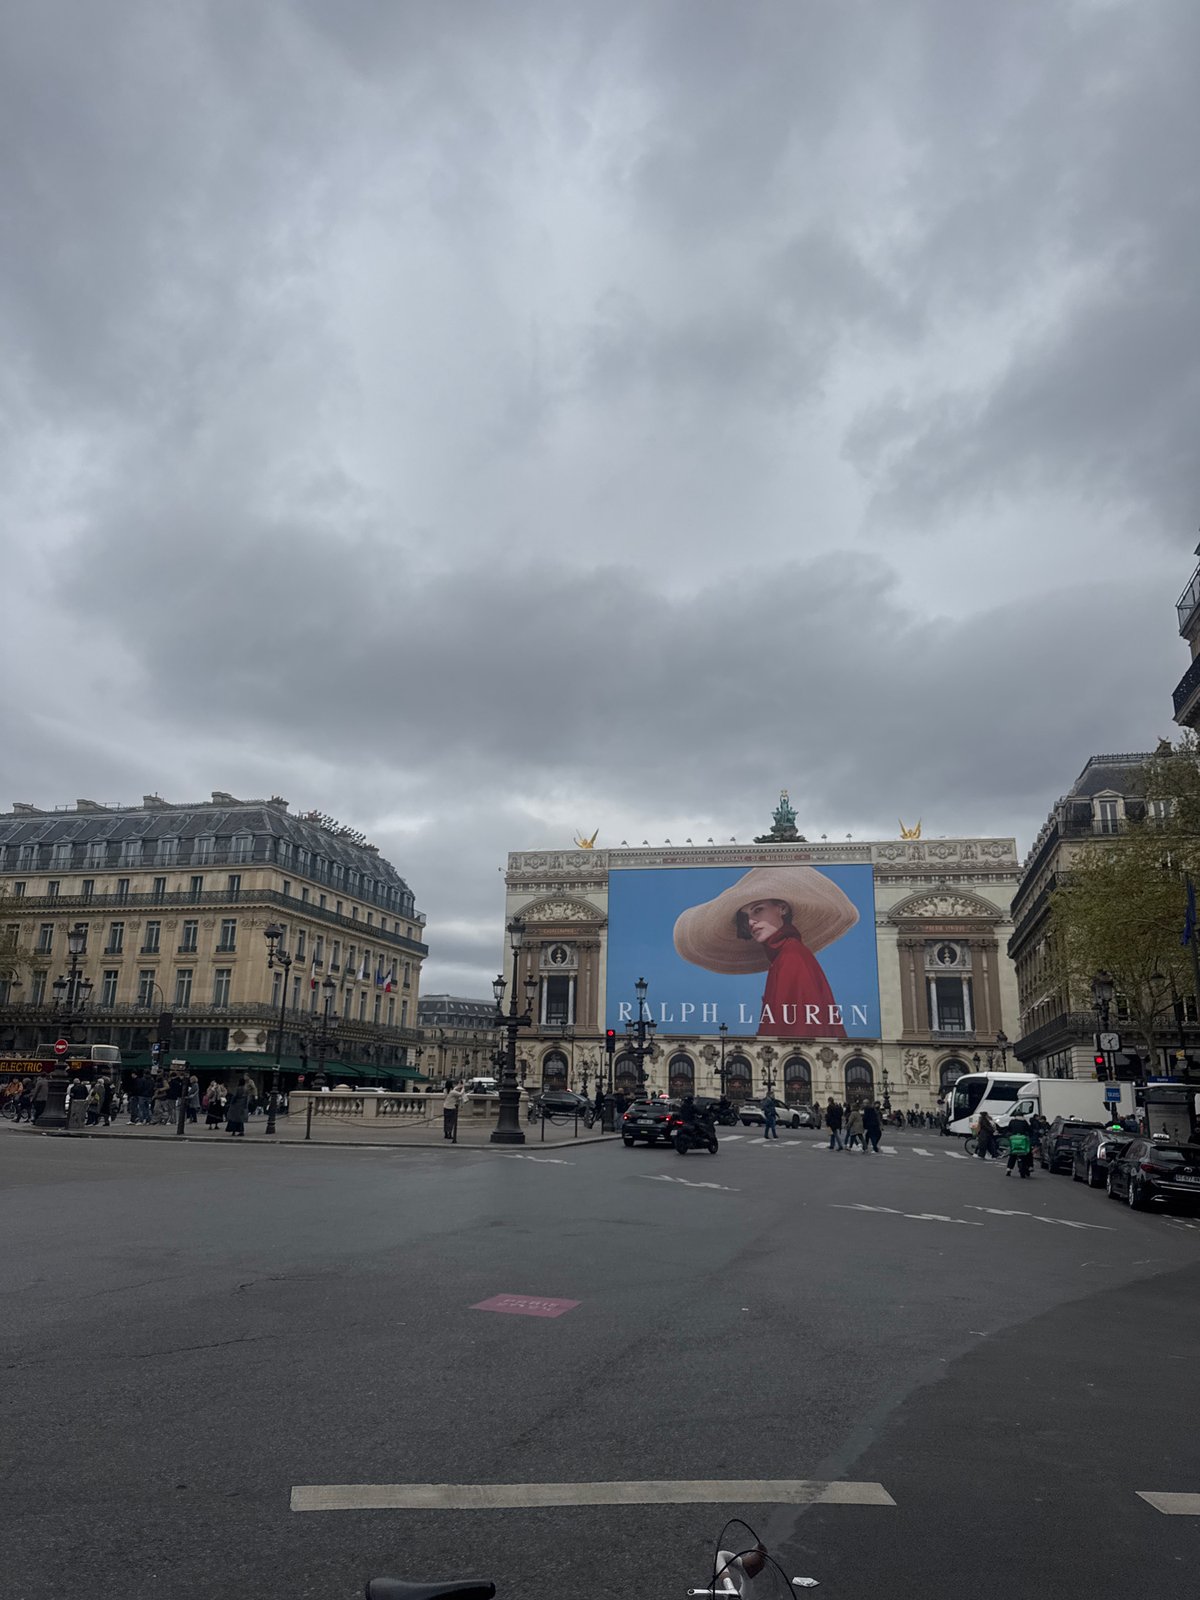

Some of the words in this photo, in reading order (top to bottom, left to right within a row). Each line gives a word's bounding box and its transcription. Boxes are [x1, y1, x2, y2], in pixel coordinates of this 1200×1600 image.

[618, 1002, 718, 1023] RALPH
[738, 1003, 869, 1026] LAUREN
[0, 1062, 43, 1073] ELECTRIC
